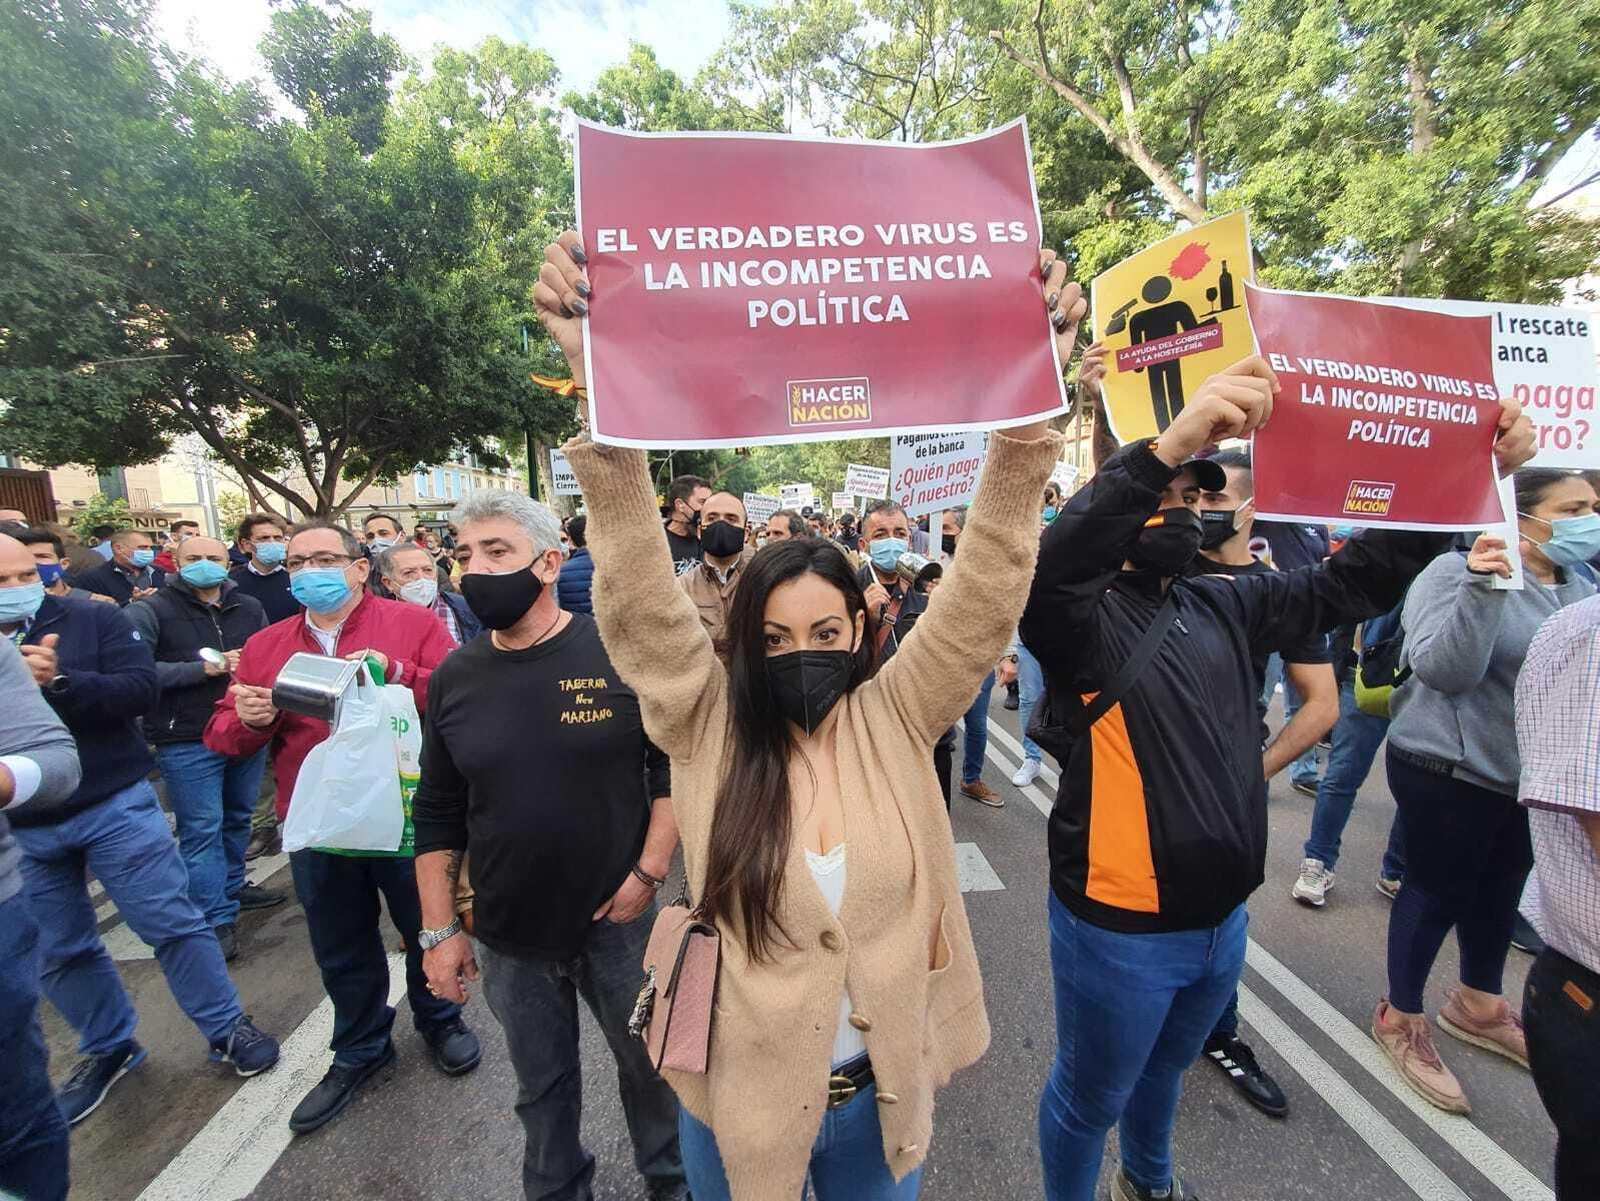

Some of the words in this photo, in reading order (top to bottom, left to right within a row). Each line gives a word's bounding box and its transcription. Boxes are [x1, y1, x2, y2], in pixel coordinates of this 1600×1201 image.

[597, 229, 638, 253] EL
[648, 225, 865, 250] VERDADERO
[874, 222, 978, 246] VIRUS
[987, 221, 1029, 243] ES
[644, 263, 690, 290] LA
[700, 254, 992, 288] INCOMPETENCIA
[747, 290, 910, 328] POLÍTICA
[1510, 317, 1588, 337] rescate
[1131, 345, 1157, 357] AYUDA
[1159, 340, 1174, 350] DEL
[1175, 328, 1219, 345] GOBIERNO
[1498, 345, 1548, 363] anca
[1143, 354, 1152, 362] LA
[1269, 353, 1297, 373] EL
[1297, 357, 1418, 389] VERDADERO
[1420, 373, 1473, 397] VIRUS
[1474, 382, 1498, 401] ES
[802, 385, 865, 403] HACER
[1301, 383, 1325, 406] LA
[1331, 387, 1478, 425] INCOMPETENCIA
[1512, 384, 1594, 418] paga
[793, 401, 867, 423] NACIÓN
[1347, 419, 1430, 448] POLÍTICA
[915, 446, 927, 458] de
[929, 444, 937, 456] la
[939, 440, 965, 454] banca
[895, 462, 943, 491] ¿Quién
[946, 458, 979, 482] paga
[901, 489, 915, 508] el
[918, 476, 975, 504] nuestro?
[1356, 486, 1391, 500] HACER
[1346, 500, 1387, 513] NACIÓN
[558, 678, 608, 691] TABERNA
[560, 708, 613, 725] MARIANO
